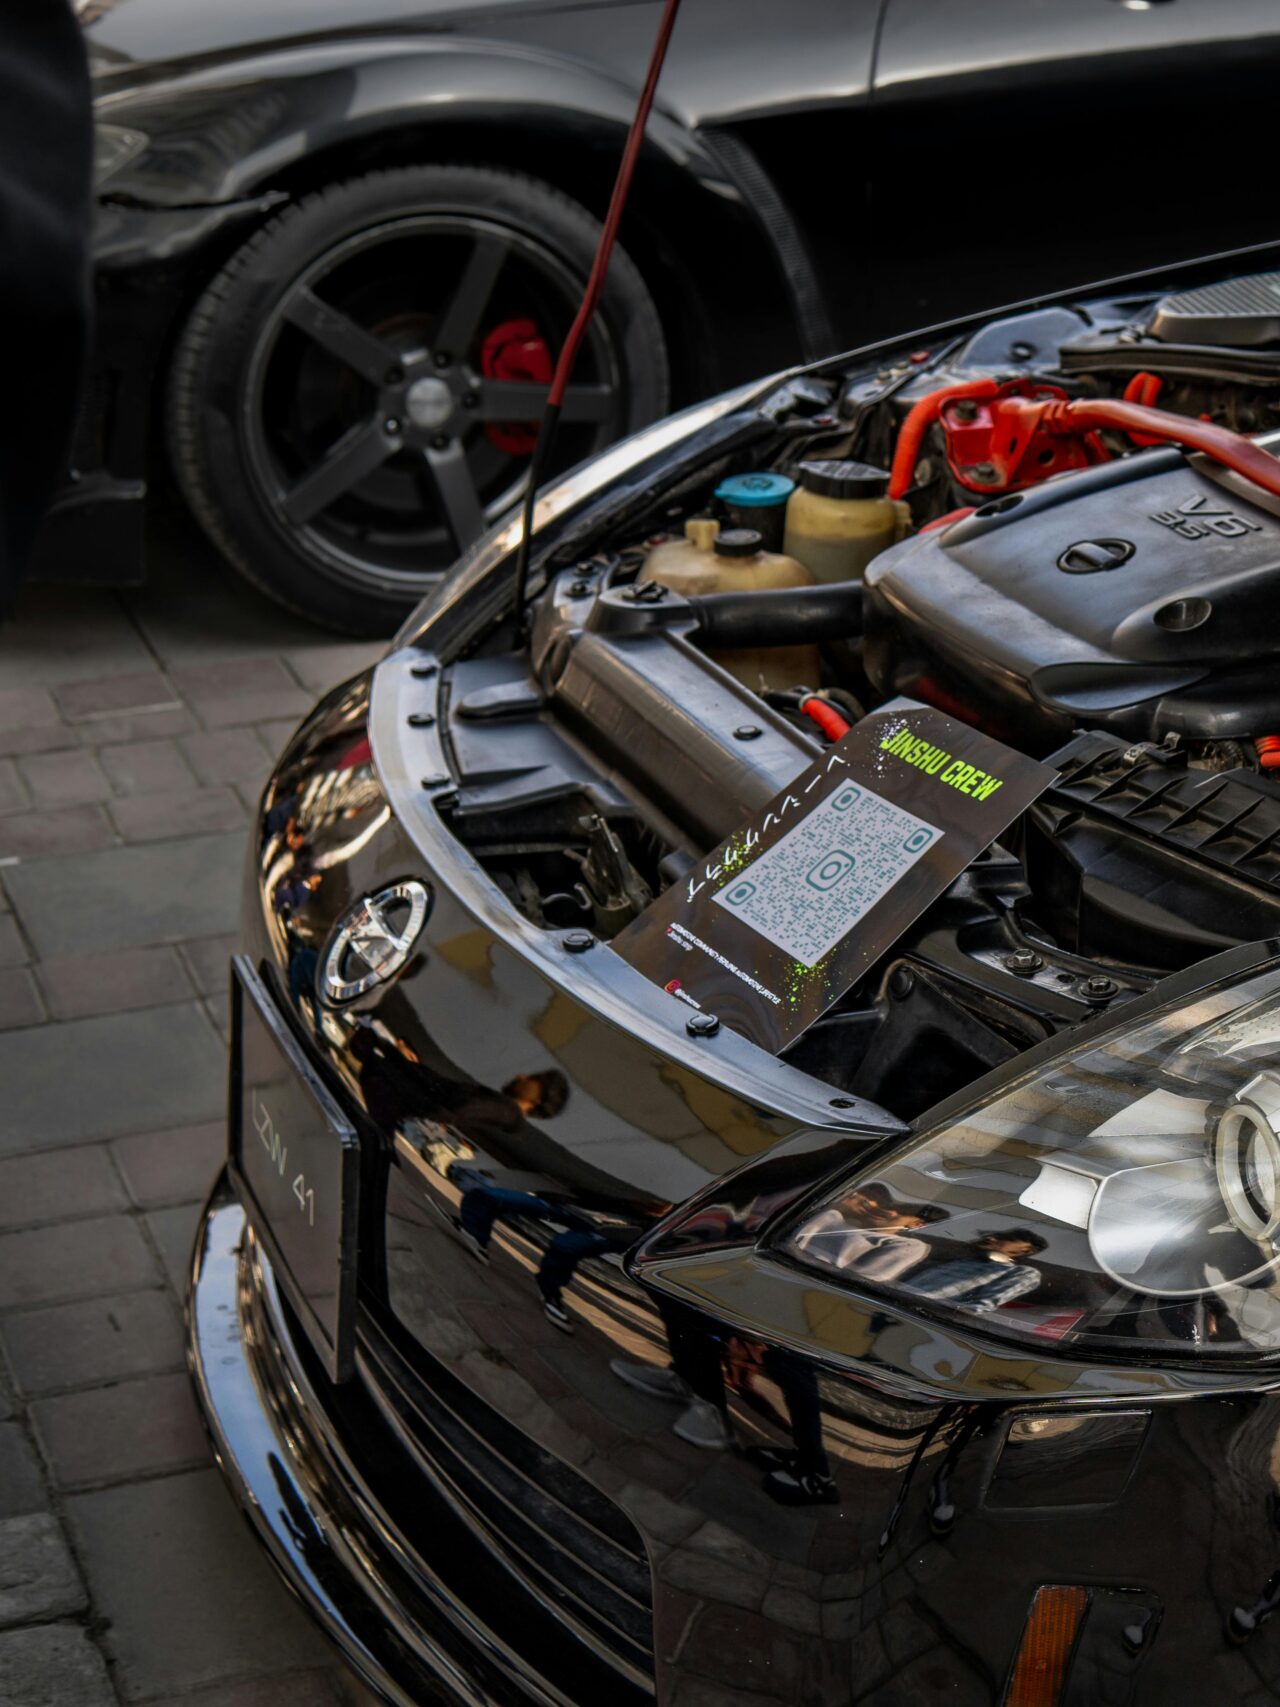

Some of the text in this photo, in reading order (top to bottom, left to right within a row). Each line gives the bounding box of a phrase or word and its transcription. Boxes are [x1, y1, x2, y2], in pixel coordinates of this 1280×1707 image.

[1149, 510, 1211, 540] 3.5
[1177, 494, 1263, 538] V6
[879, 727, 1004, 802] JINSHU CREW
